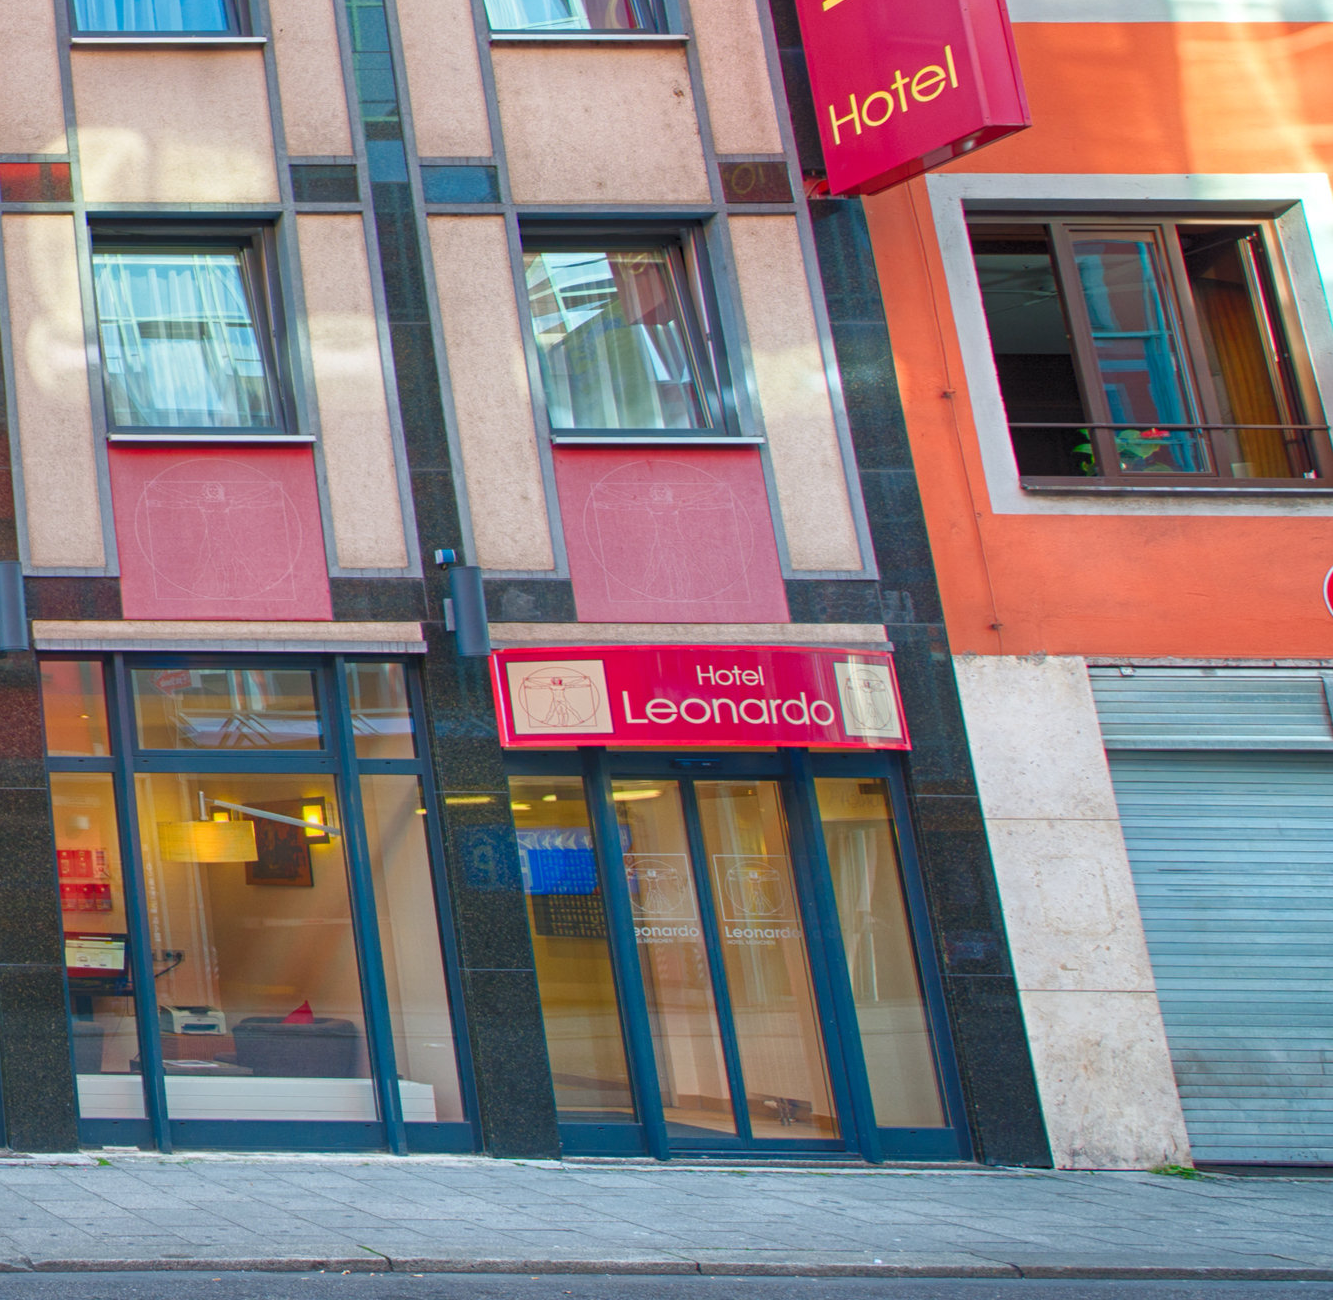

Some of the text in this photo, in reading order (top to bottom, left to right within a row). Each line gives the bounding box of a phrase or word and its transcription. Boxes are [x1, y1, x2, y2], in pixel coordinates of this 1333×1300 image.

[827, 45, 959, 146] Hotel
[696, 664, 766, 687] Hotel
[622, 689, 835, 726] Leonardo
[633, 925, 700, 937] eonardo
[724, 925, 802, 939] Leonardo
